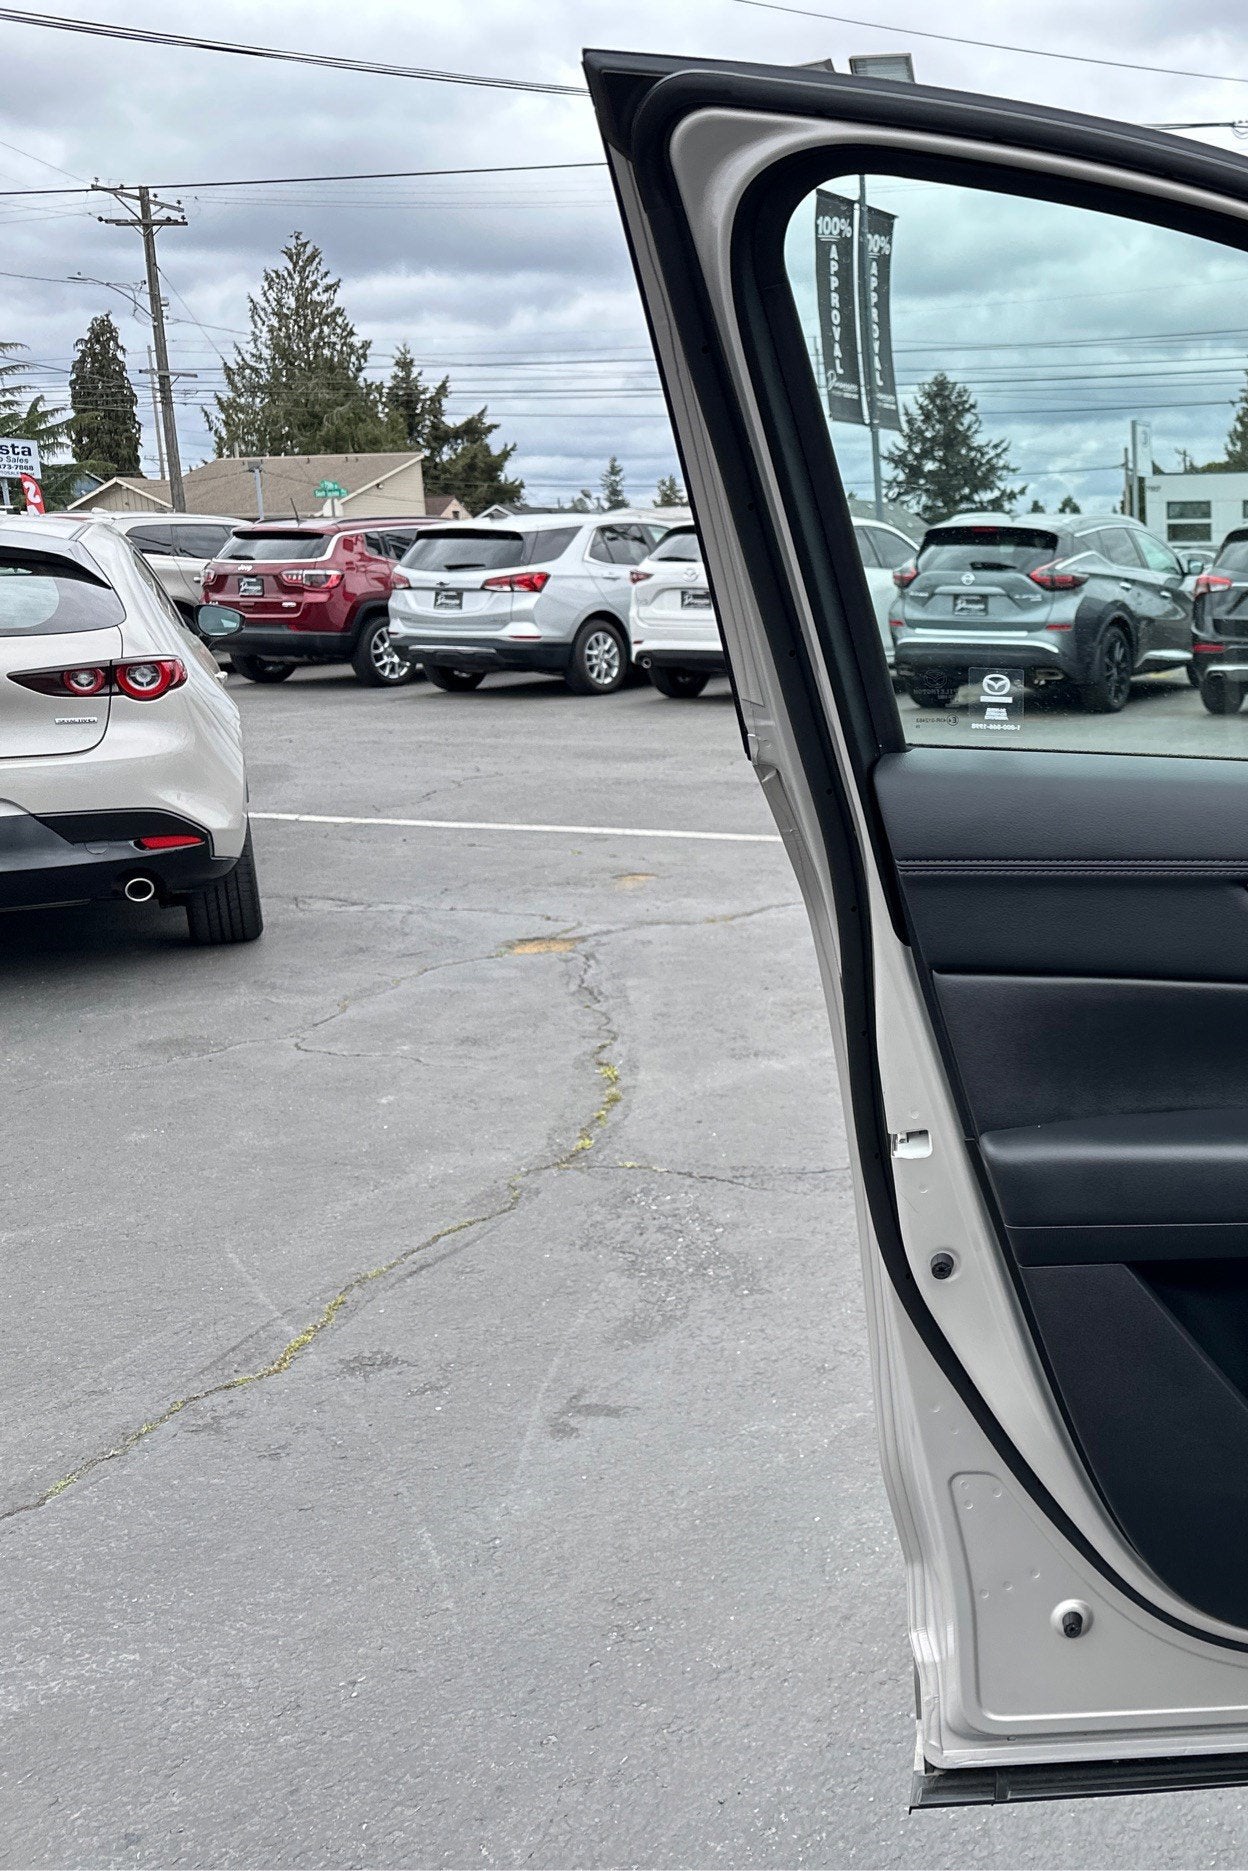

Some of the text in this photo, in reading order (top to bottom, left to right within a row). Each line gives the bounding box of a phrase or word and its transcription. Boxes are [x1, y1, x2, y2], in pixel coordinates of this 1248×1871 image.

[817, 216, 852, 238] 100%
[829, 244, 844, 374] APPROVAL
[870, 261, 884, 386] APPROVAL
[6, 456, 29, 464] Sales
